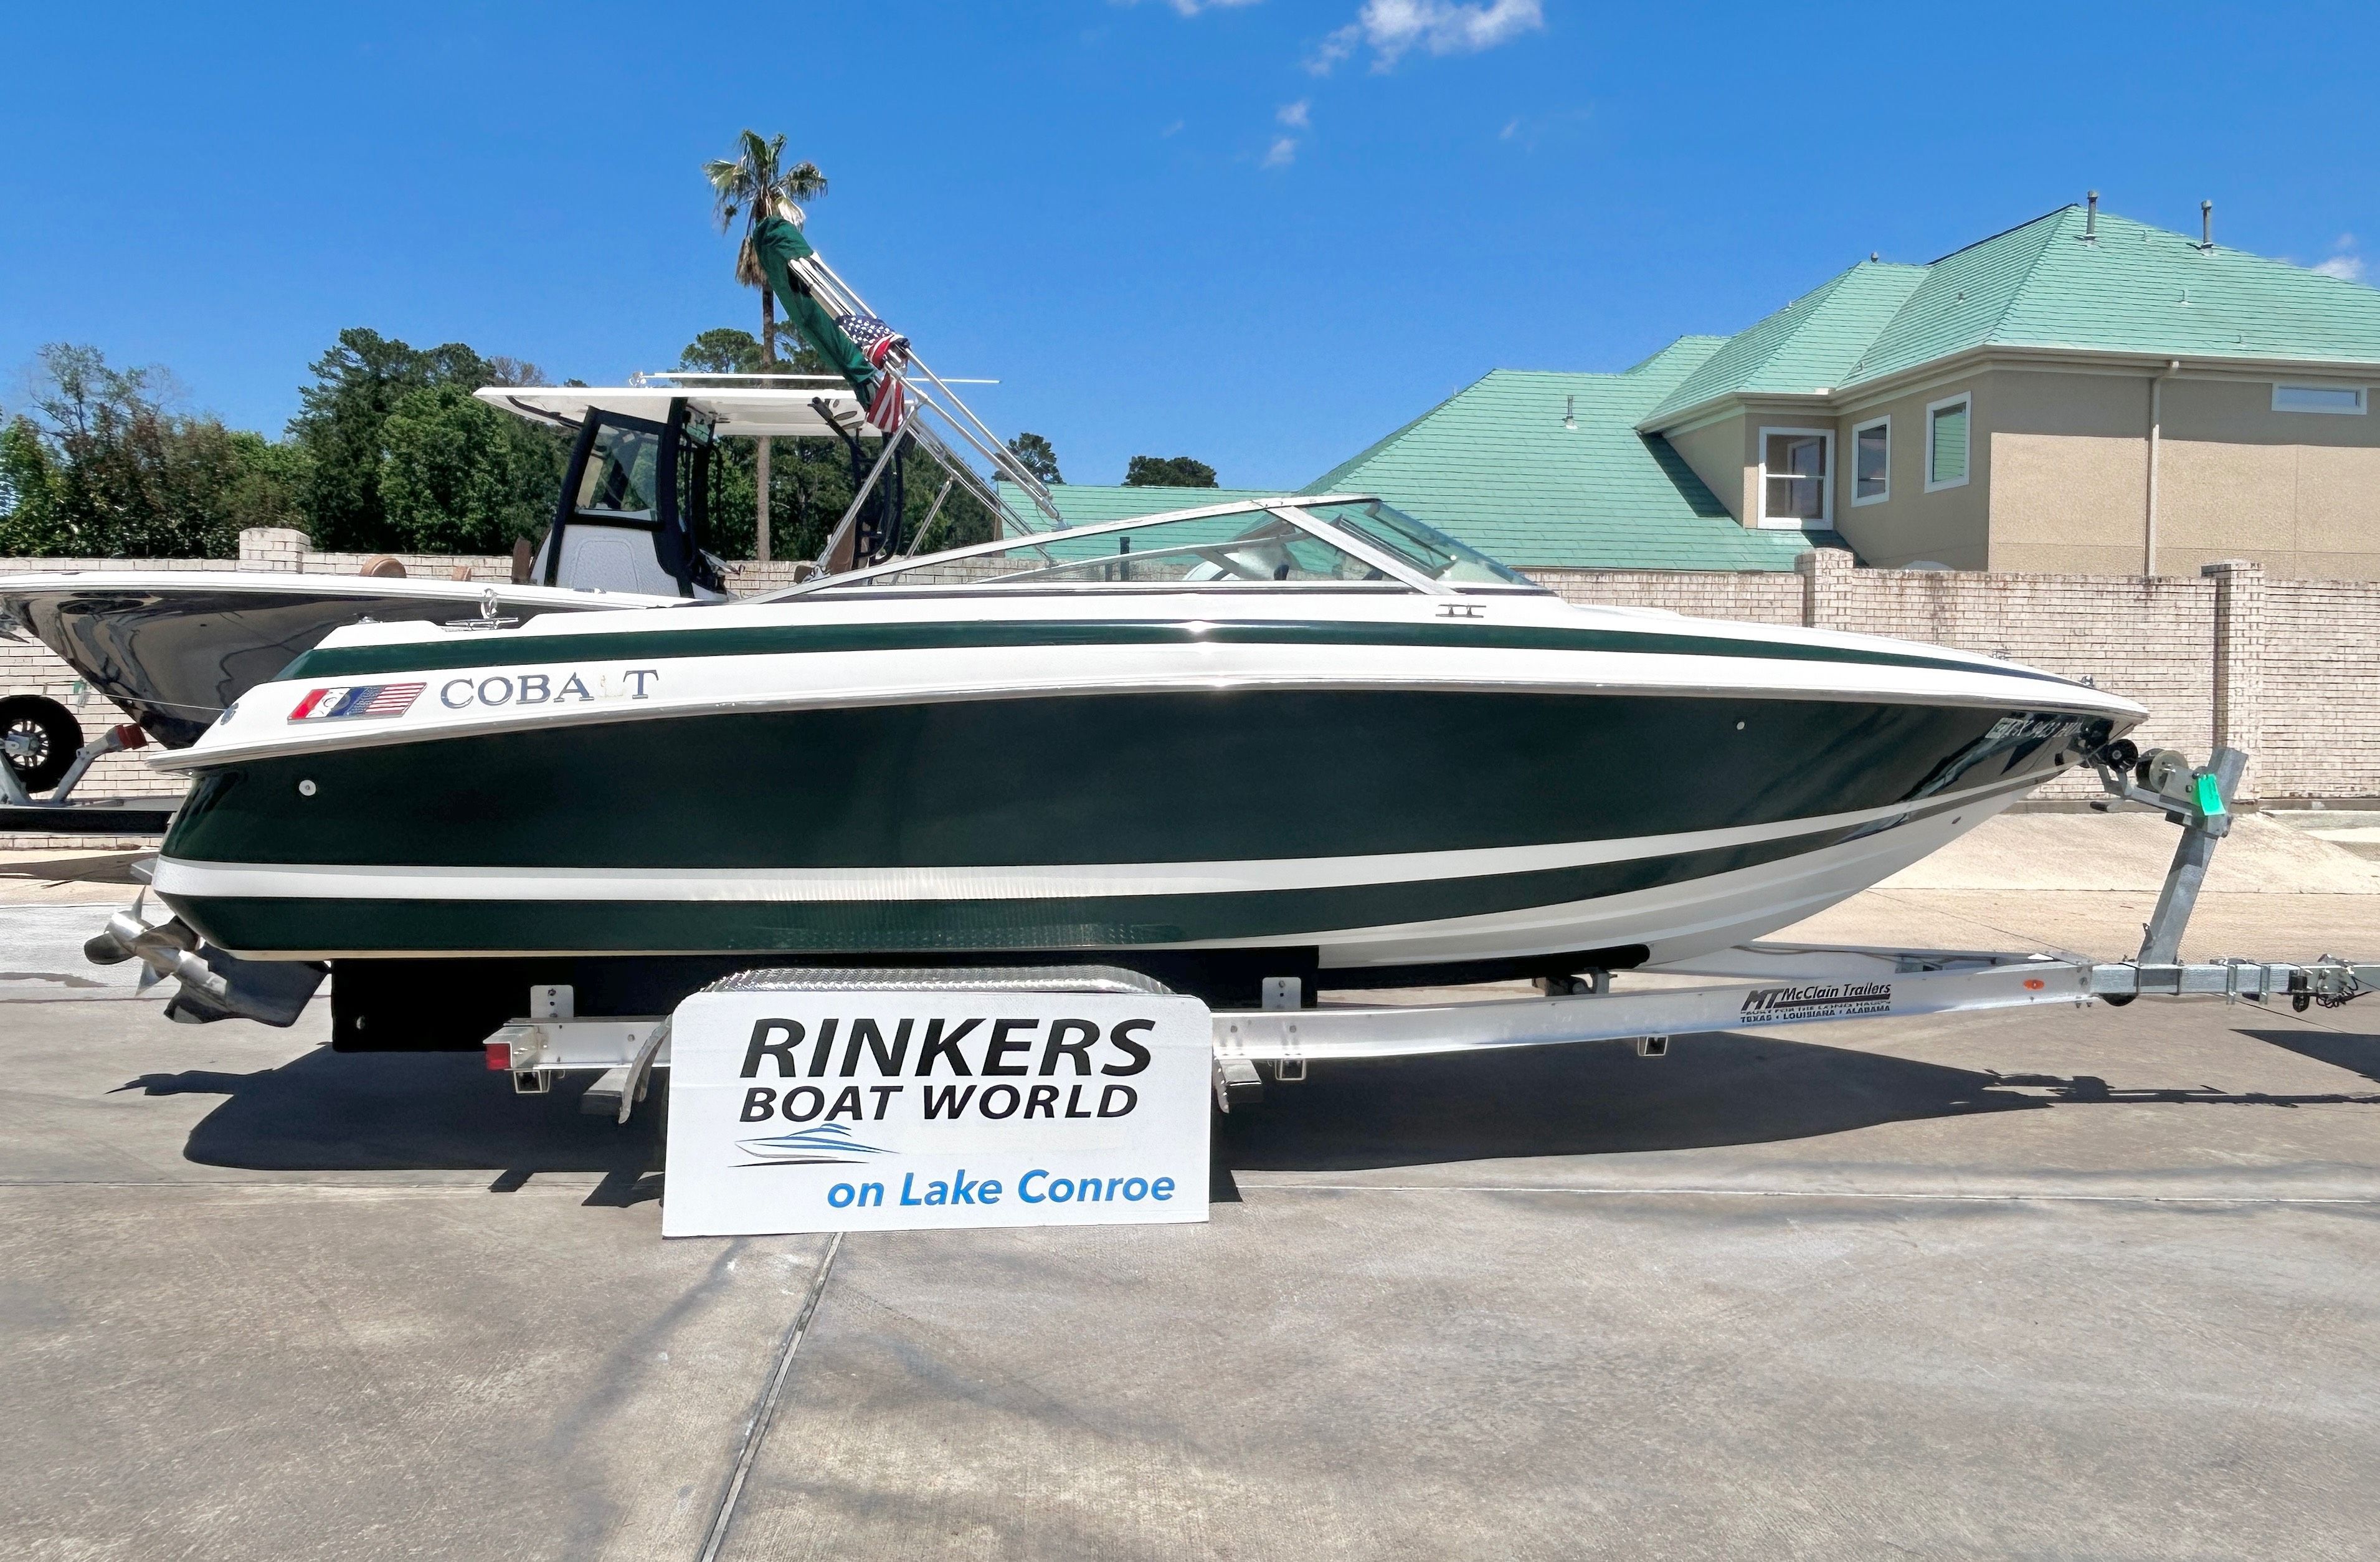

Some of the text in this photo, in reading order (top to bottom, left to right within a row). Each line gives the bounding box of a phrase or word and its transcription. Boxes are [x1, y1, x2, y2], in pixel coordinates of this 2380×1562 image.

[440, 669, 658, 709] COBAT
[1781, 986, 1839, 1001] McClain
[1844, 982, 1891, 996] Trailers
[1846, 1005, 1890, 1014] ALABAMA
[740, 1018, 1155, 1077] RINKERS
[740, 1084, 1138, 1122] BOAT WORLD
[828, 1169, 1175, 1209] on Lake Conroe
